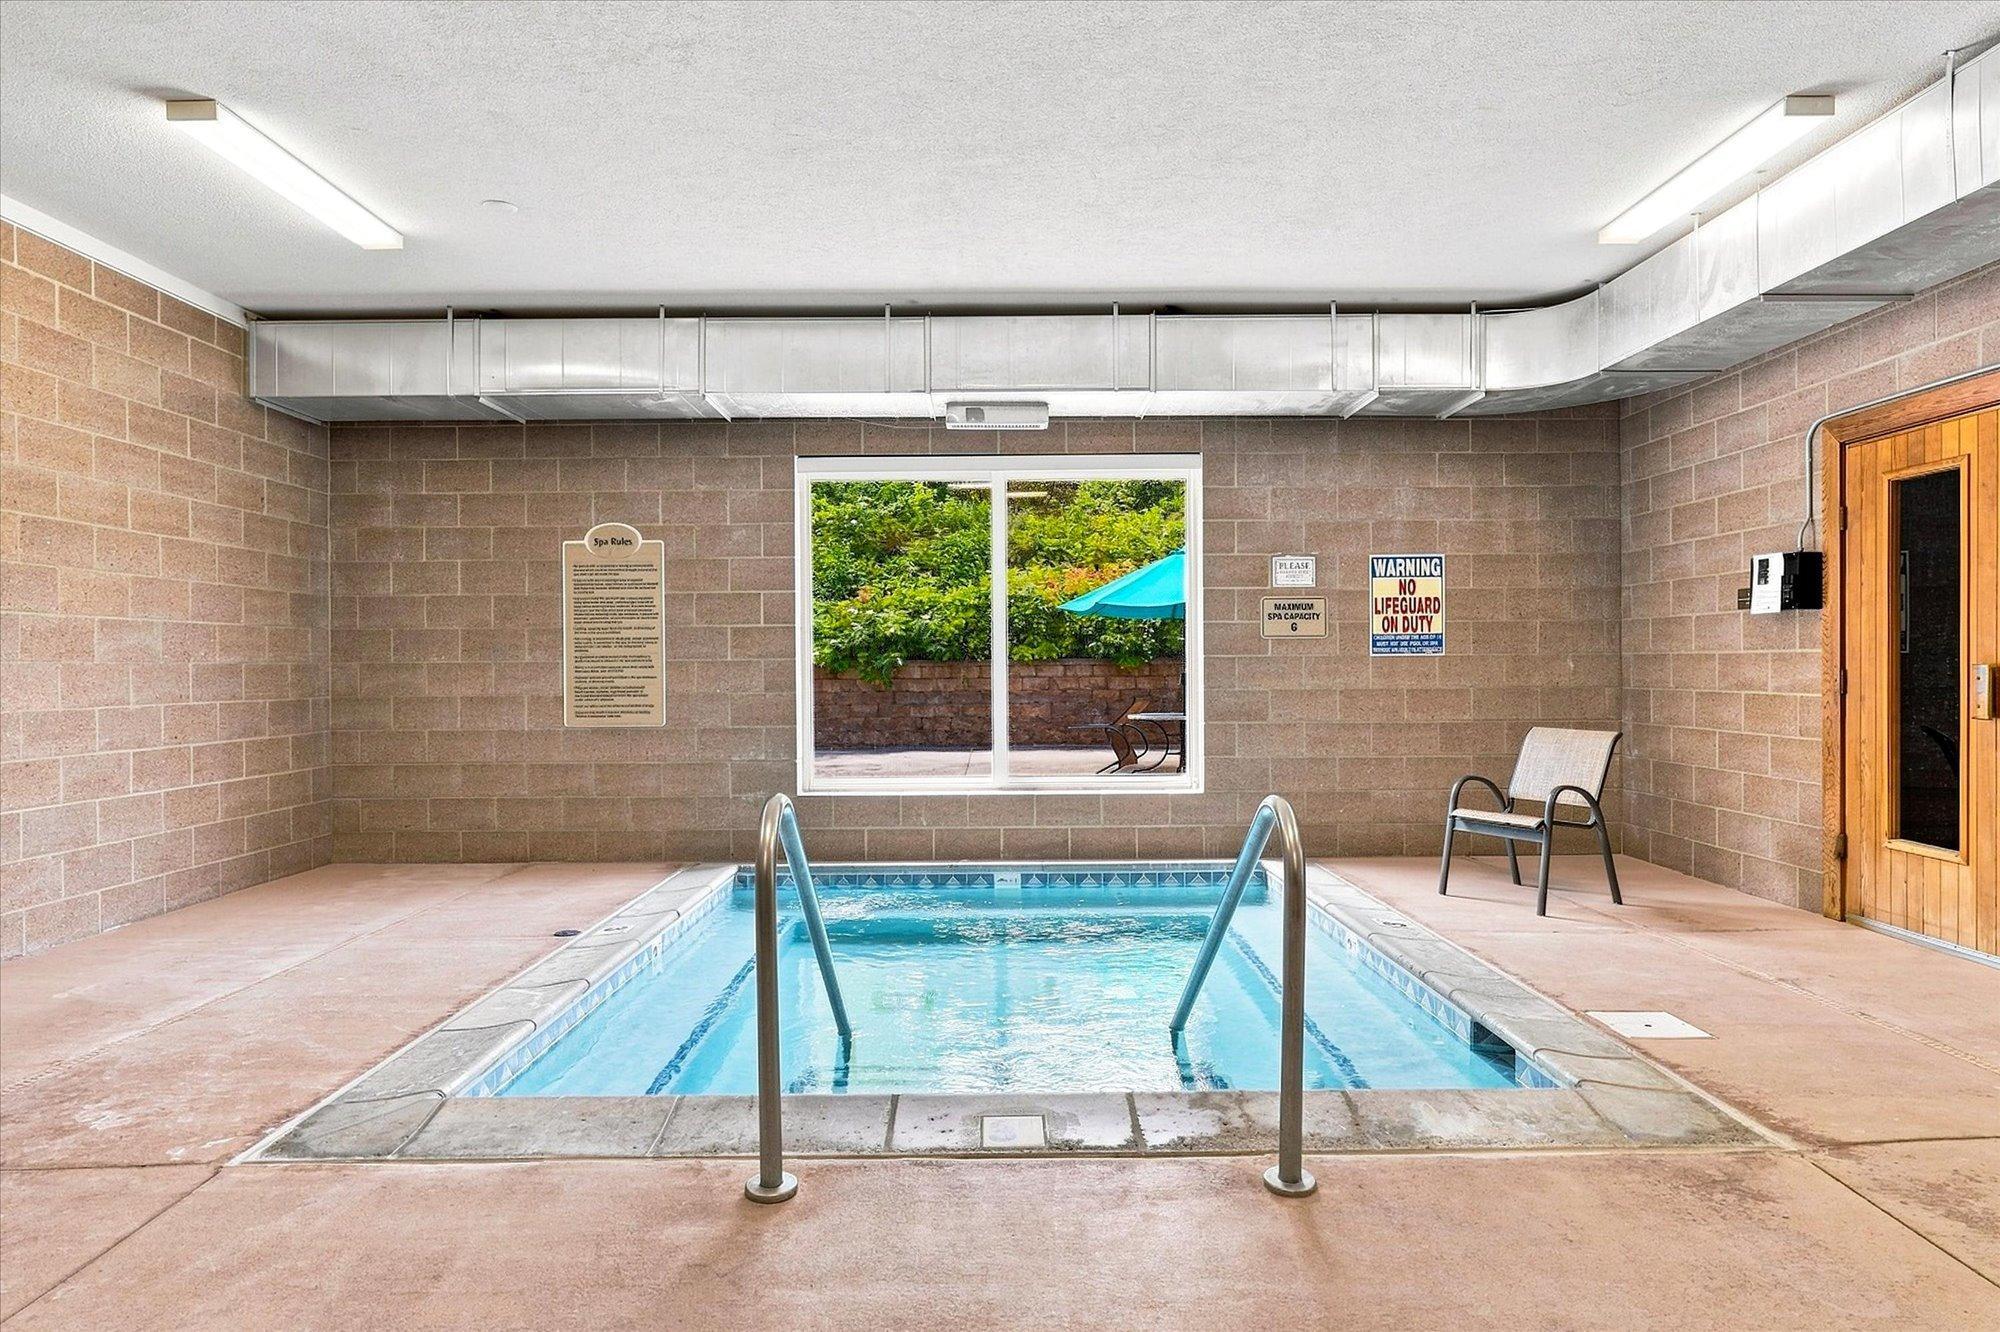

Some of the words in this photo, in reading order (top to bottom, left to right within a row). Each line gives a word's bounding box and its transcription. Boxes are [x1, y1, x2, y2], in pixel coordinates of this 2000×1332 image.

[594, 537, 608, 547] Spa
[611, 537, 632, 546] Rules
[1373, 558, 1441, 576] WARNING
[1399, 578, 1416, 596] NO
[1374, 596, 1441, 614] LIFEGUARD
[1290, 622, 1298, 632] 6
[1382, 616, 1398, 633] ON
[1402, 616, 1433, 633] DUTY
